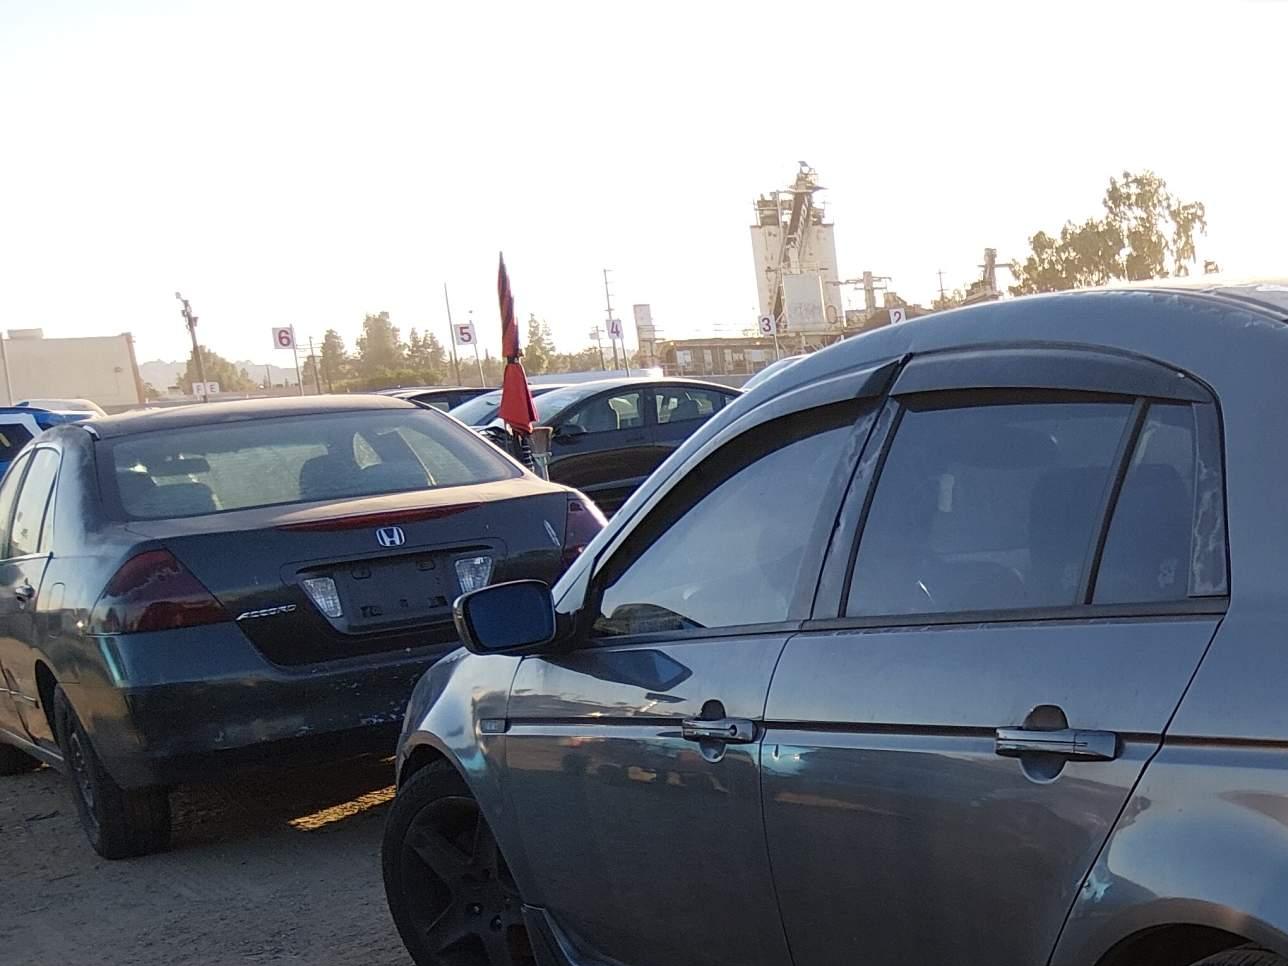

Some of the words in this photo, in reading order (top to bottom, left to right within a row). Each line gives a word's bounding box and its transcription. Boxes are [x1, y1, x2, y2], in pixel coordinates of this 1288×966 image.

[610, 320, 621, 337] 4
[761, 317, 772, 332] 3
[278, 329, 291, 347] 6
[459, 326, 472, 342] 5
[235, 604, 297, 621] ACCORD
